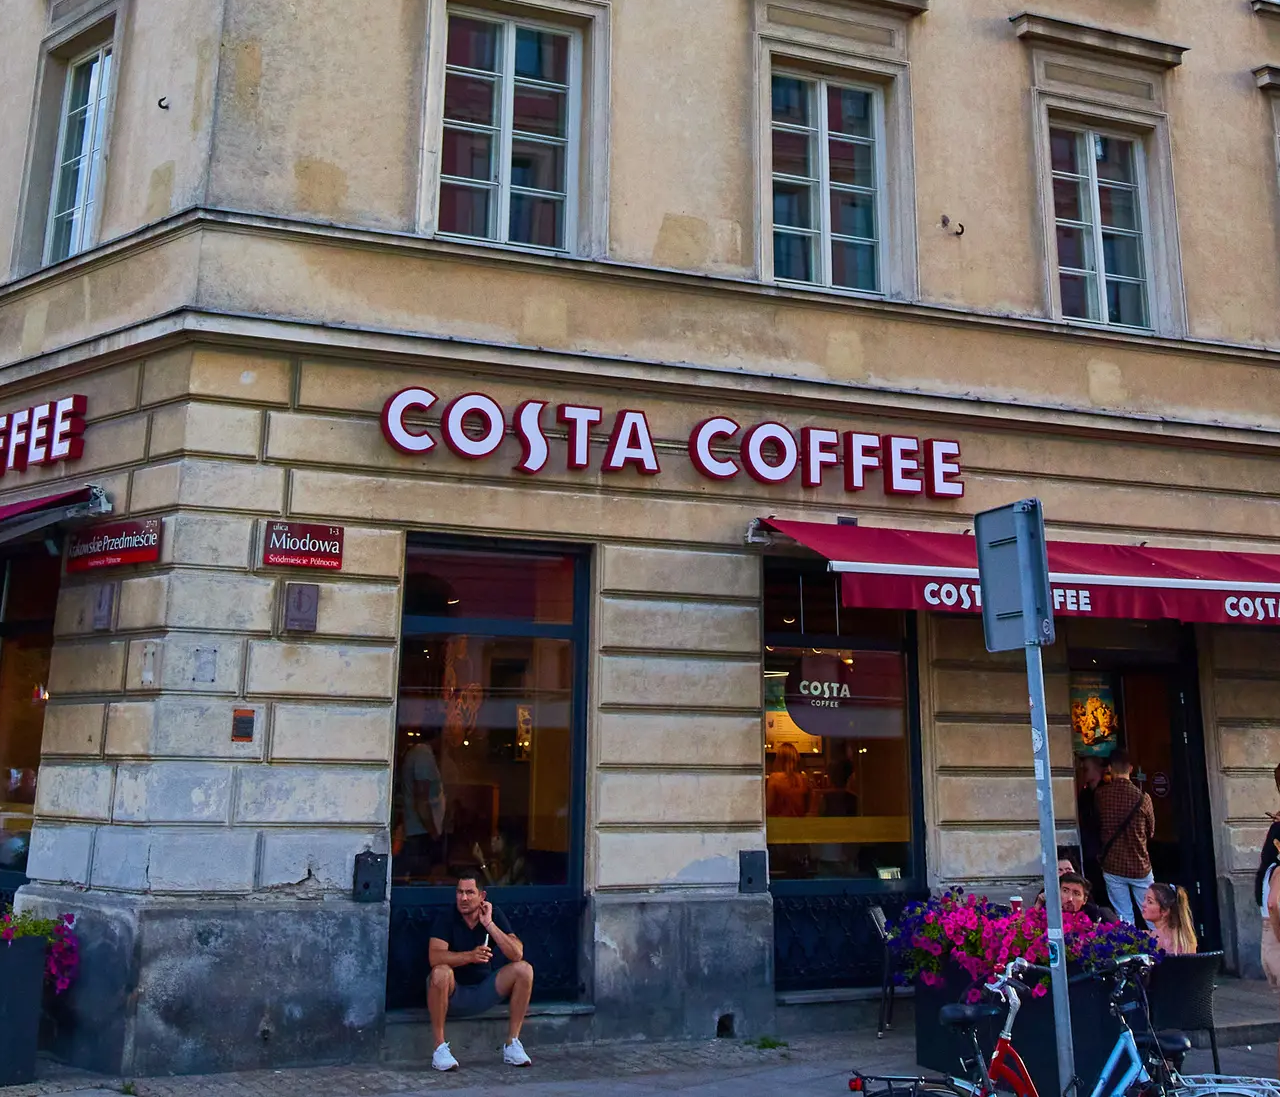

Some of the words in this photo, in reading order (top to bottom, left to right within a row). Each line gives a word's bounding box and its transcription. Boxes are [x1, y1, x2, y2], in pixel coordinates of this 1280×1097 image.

[380, 386, 660, 474] COSTA
[689, 416, 965, 499] COFFEE
[273, 523, 289, 531] ulica
[102, 529, 158, 551] Przedmieście
[269, 532, 340, 554] Miodowa
[269, 554, 308, 565] Śródmieście
[310, 557, 339, 567] Północne
[924, 582, 982, 609] COST
[1052, 588, 1092, 611] FEE
[799, 680, 851, 698] COSTA
[811, 699, 839, 708] COFFEE
